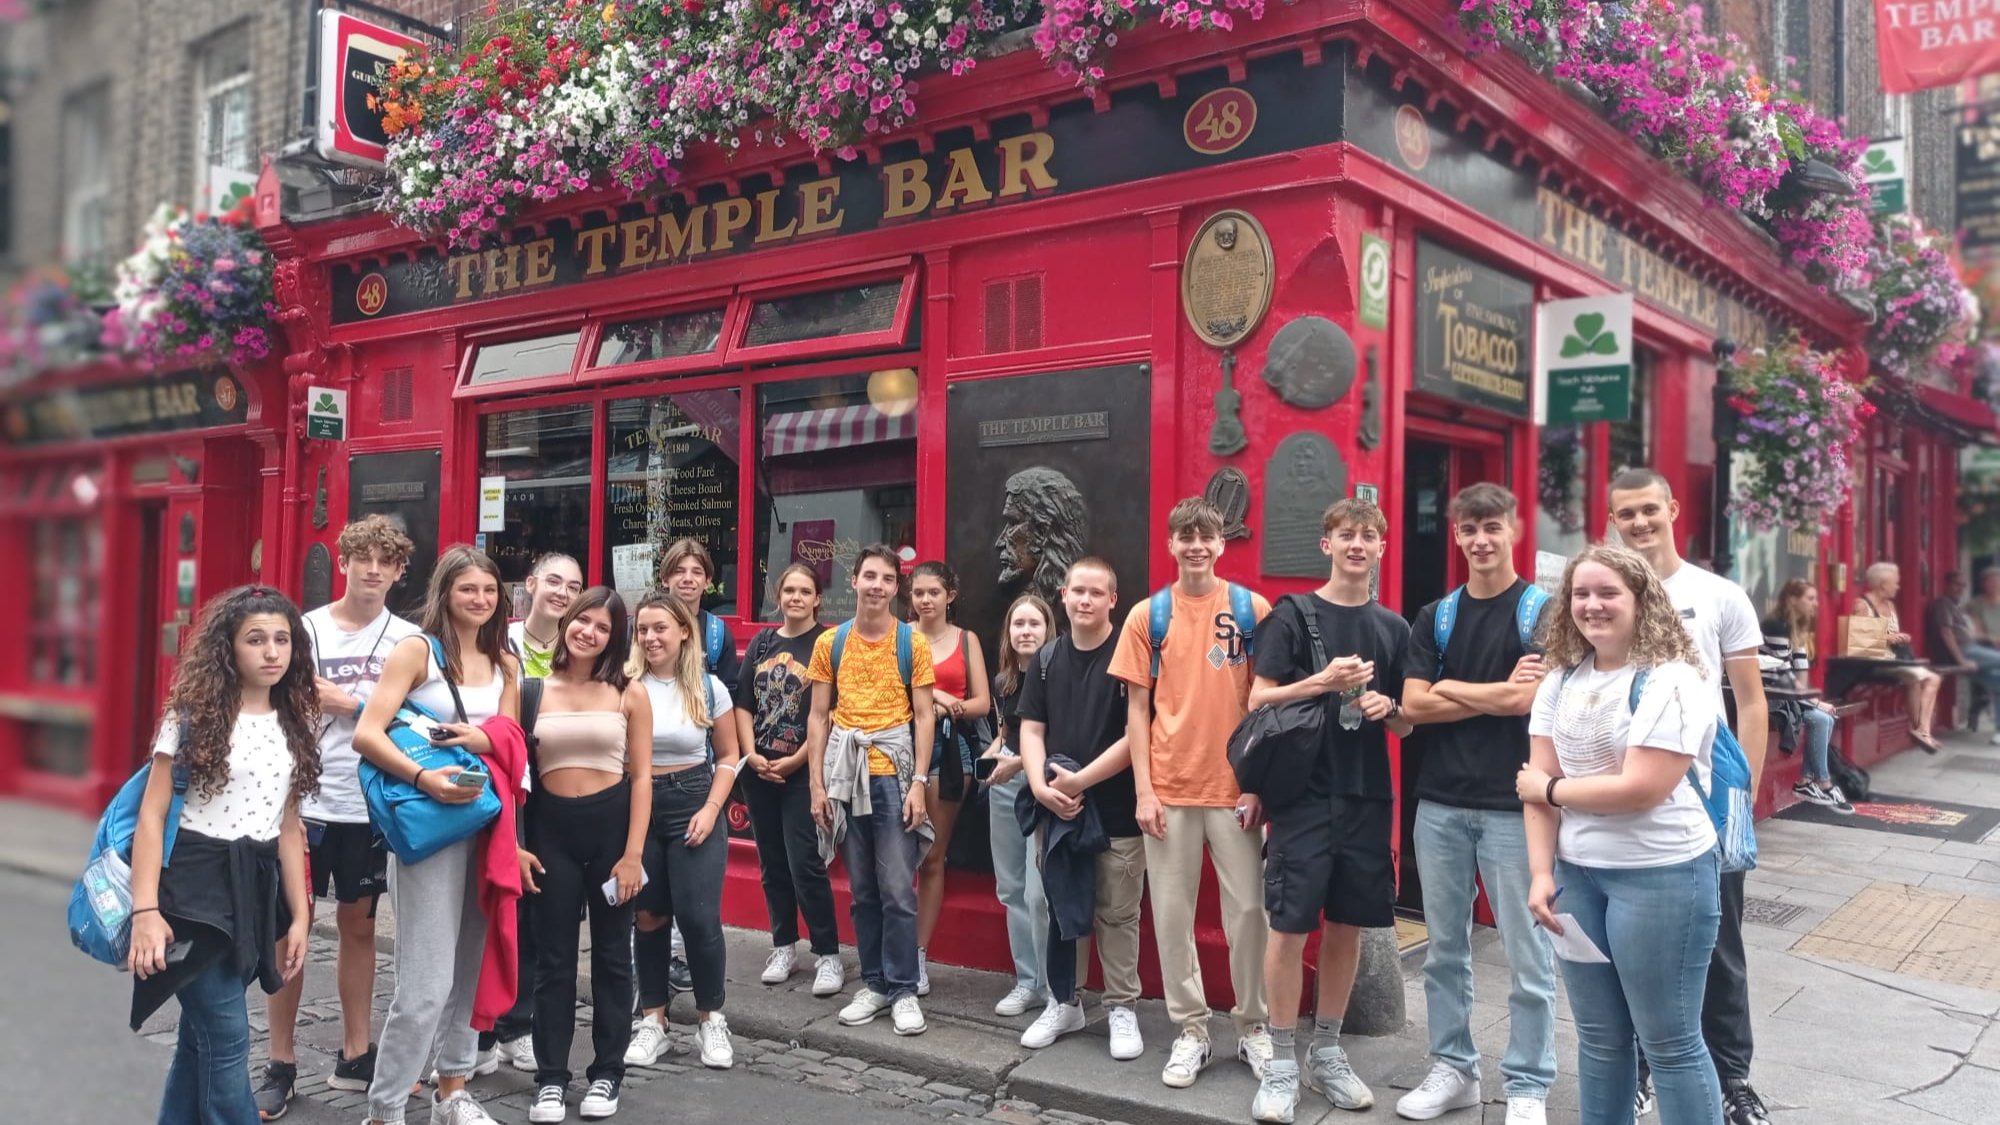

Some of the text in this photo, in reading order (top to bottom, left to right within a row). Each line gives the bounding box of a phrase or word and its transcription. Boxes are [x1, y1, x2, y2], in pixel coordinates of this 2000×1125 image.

[1920, 18, 1996, 50] BAR
[1194, 100, 1243, 143] 48
[449, 131, 1059, 298] THE TEMPLE BAR
[1537, 186, 1608, 273] THE
[1615, 232, 1720, 331] TEMPLE
[361, 282, 381, 308] 48
[1440, 302, 1518, 374] TOBACCO
[155, 383, 202, 419] BAR
[980, 412, 1105, 436] THE TEMPLE BAR
[671, 442, 690, 454] 1840
[674, 466, 695, 479] Food
[697, 466, 716, 477] Fare
[668, 483, 696, 496] Cheese
[697, 481, 722, 494] Board
[613, 503, 634, 514] Fresh
[667, 499, 700, 512] Smoked
[701, 498, 732, 510] Salmon
[668, 517, 693, 529] Meats,
[695, 514, 721, 527] Olives
